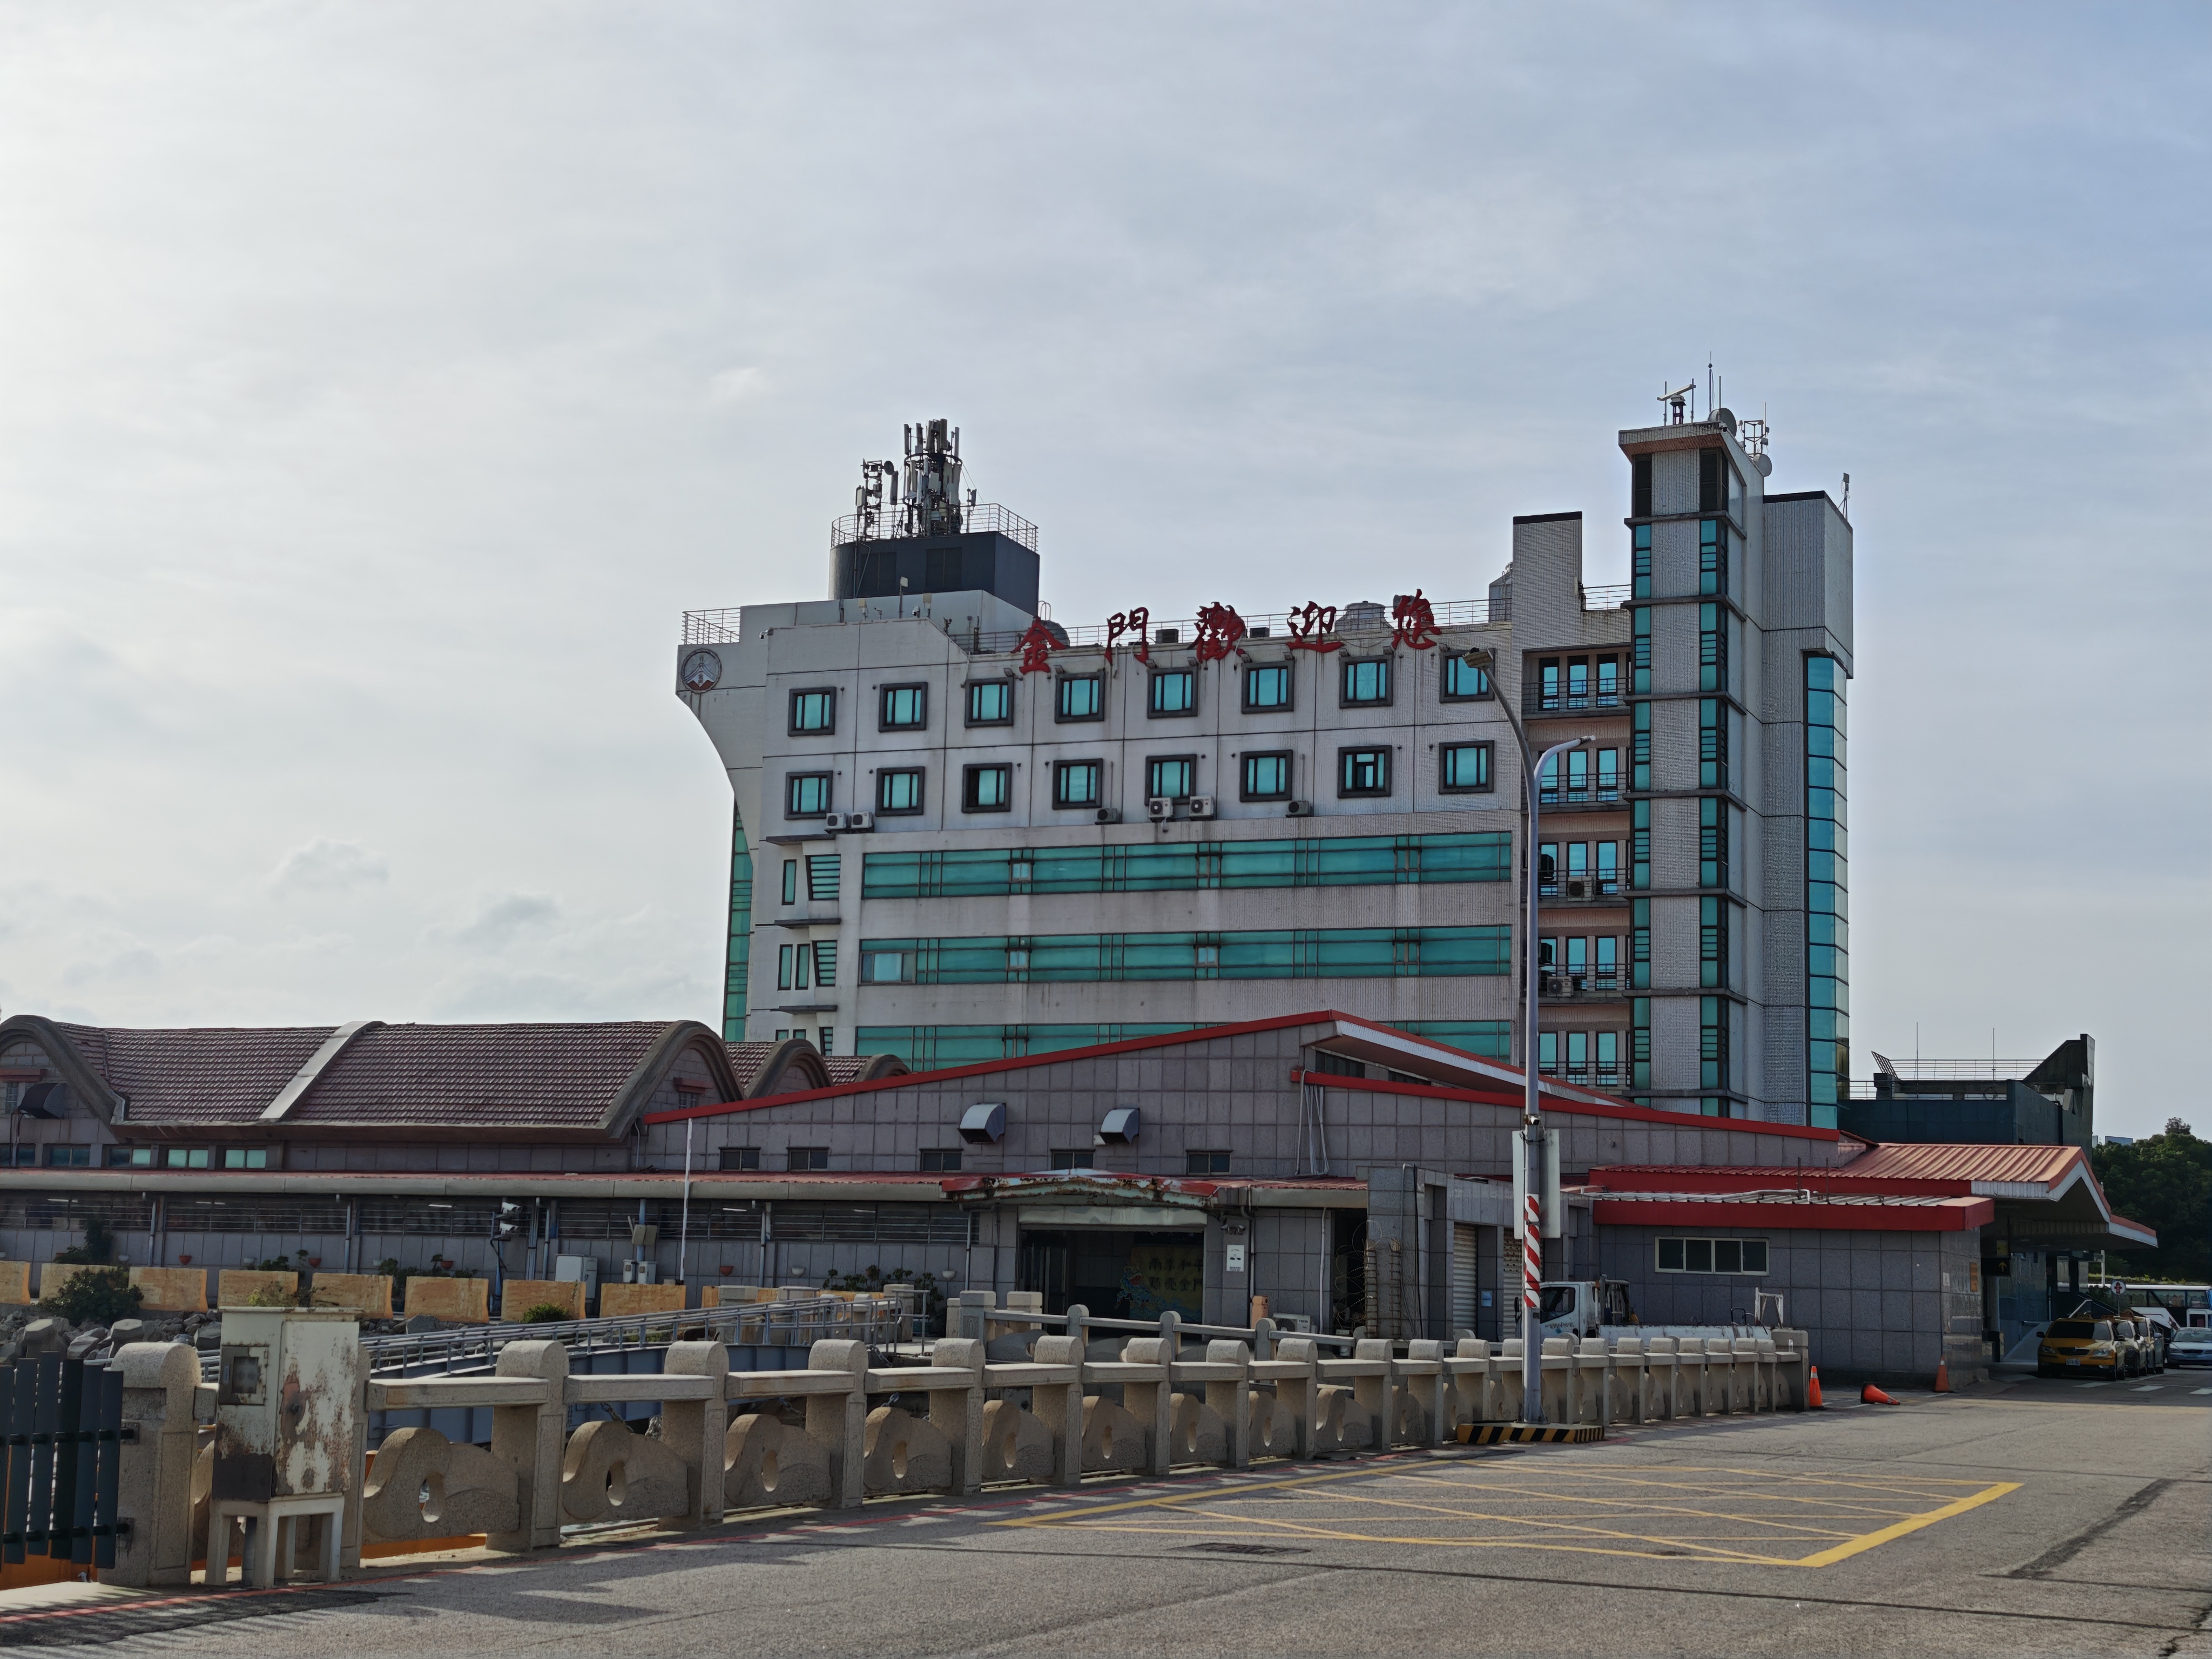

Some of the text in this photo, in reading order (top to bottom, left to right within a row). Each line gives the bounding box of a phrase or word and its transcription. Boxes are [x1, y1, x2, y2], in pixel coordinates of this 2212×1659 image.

[1010, 589, 1442, 674] 金門歡迎您
